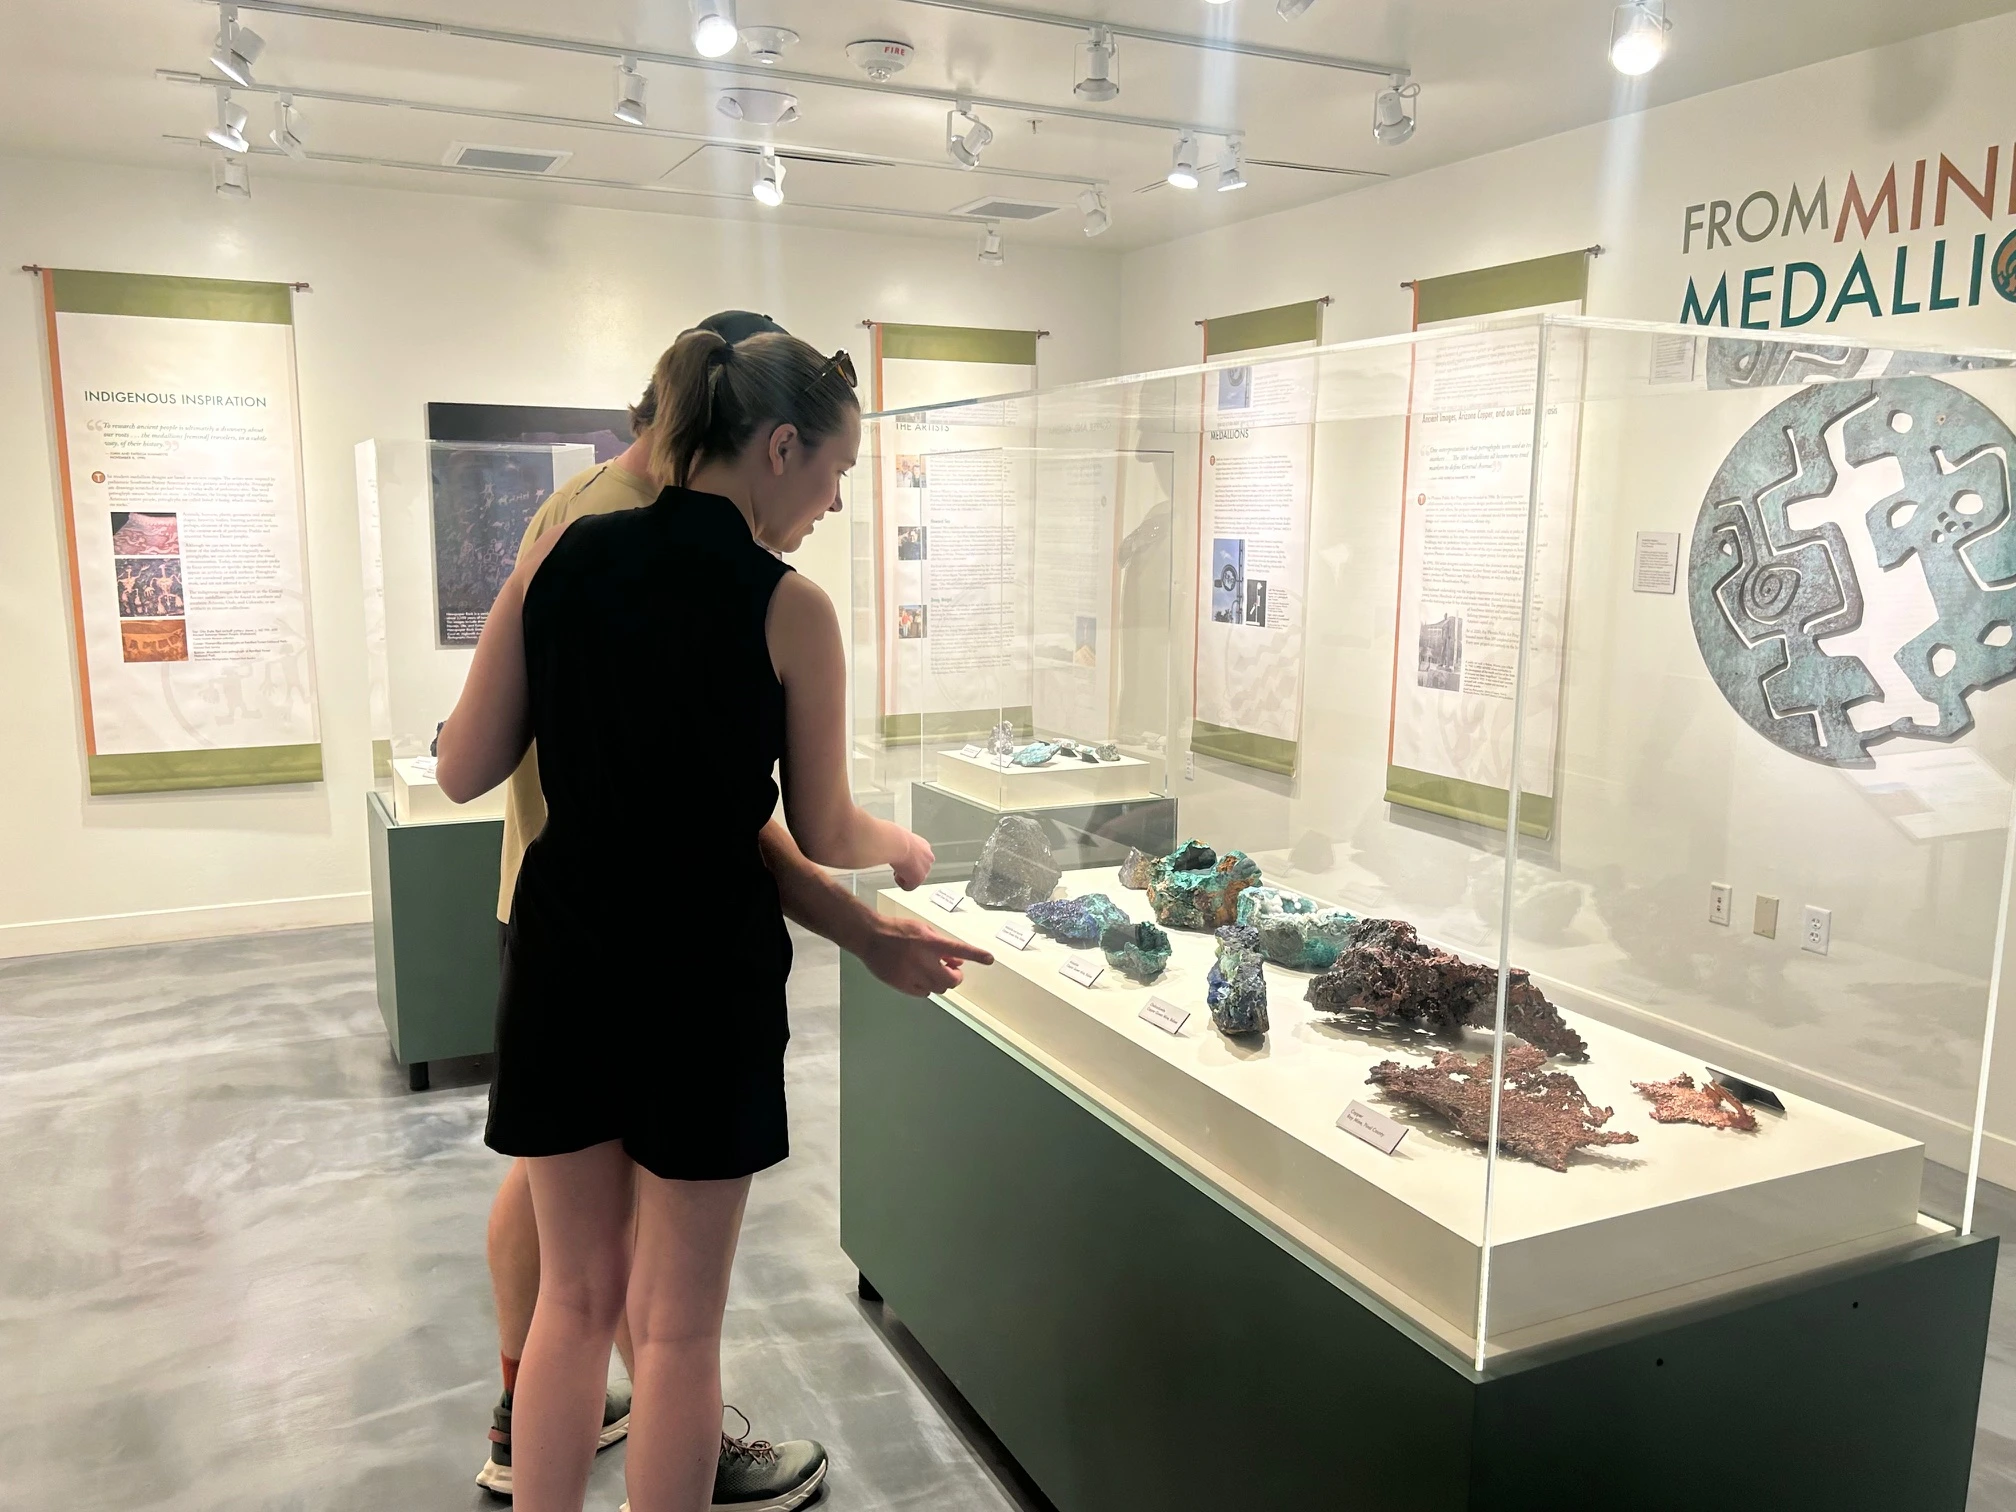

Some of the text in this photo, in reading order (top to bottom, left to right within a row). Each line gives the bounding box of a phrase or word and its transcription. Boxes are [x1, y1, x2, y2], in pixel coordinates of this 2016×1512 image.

[884, 46, 905, 56] FIRE
[1682, 175, 1829, 255] FROM
[84, 390, 267, 408] INDIGENOUS INSPIRATION
[1422, 412, 1438, 423] Ancient
[1440, 411, 1457, 423] Images,
[1458, 410, 1476, 420] Arizona
[1477, 409, 1494, 420] Copper,
[1496, 408, 1505, 417] and
[1506, 409, 1515, 417] our
[1516, 406, 1531, 416] Urban
[160, 424, 178, 432] people
[1210, 428, 1249, 440] MEDALLIONS
